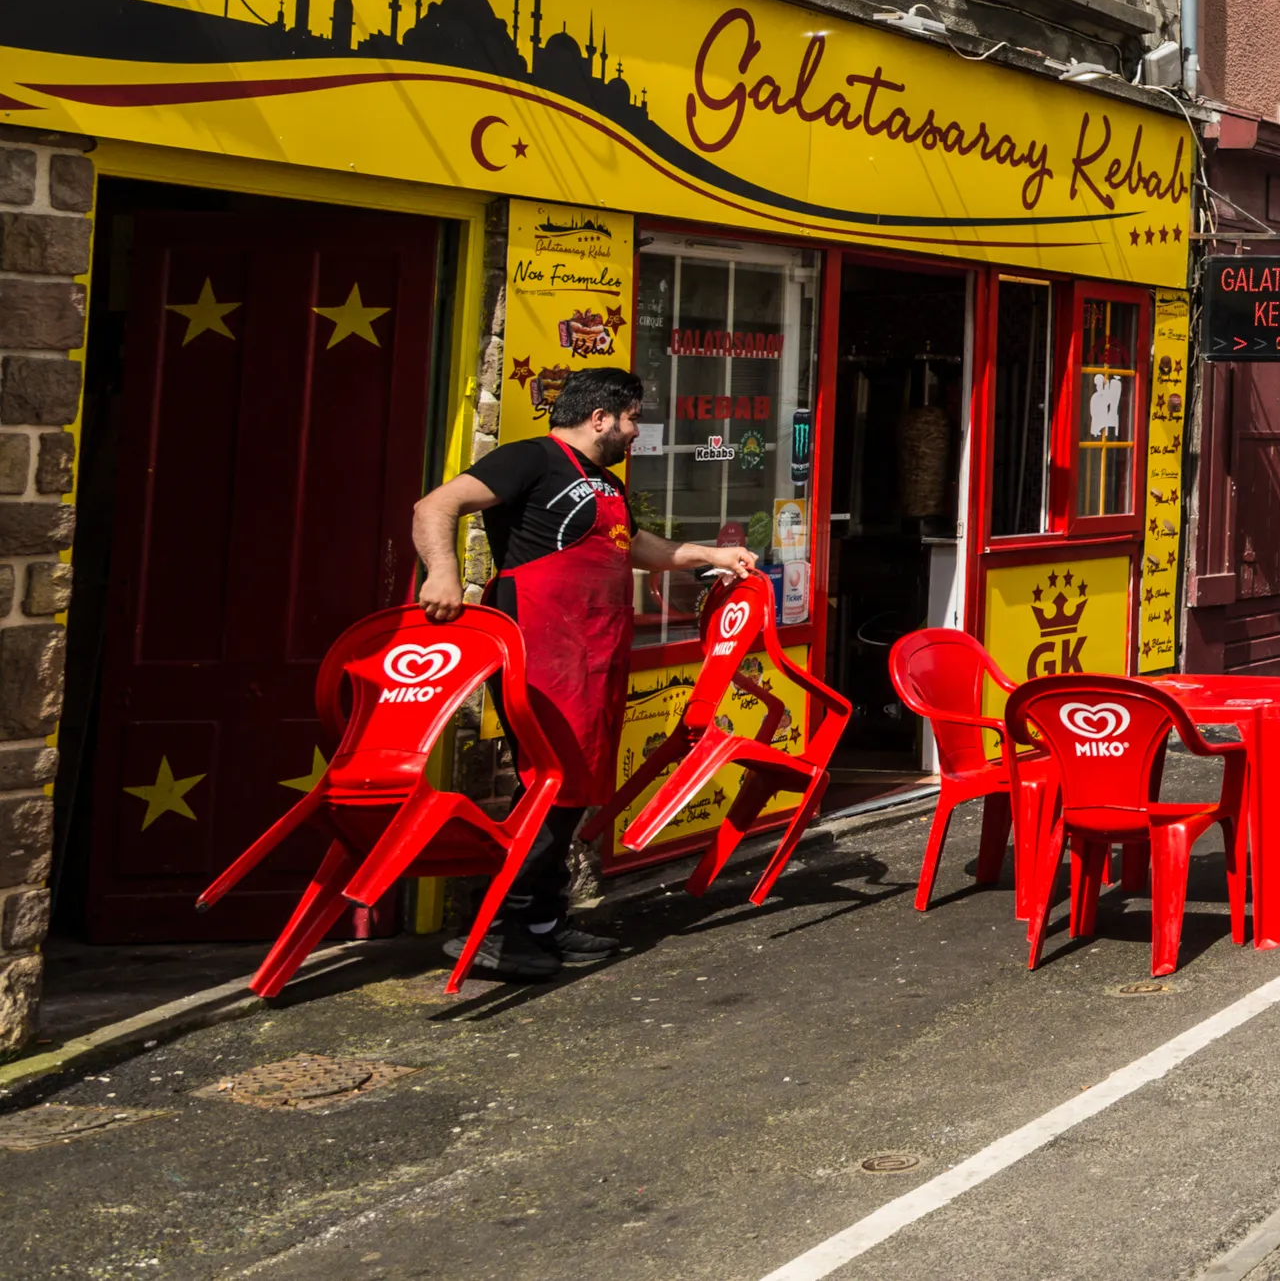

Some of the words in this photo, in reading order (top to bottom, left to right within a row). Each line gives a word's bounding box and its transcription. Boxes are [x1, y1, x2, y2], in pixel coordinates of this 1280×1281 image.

[686, 8, 1054, 210] Galatasaray
[1069, 112, 1189, 210] Kebab
[534, 239, 586, 260] Galatasaray
[588, 245, 611, 259] Kebab
[513, 260, 545, 284] Nos
[550, 263, 622, 289] Formules
[608, 315, 621, 327] 5€
[572, 338, 616, 359] Kebab
[670, 328, 785, 359] GALATASARAY
[676, 396, 772, 421] KEBAB
[696, 448, 734, 459] Kebabs
[712, 641, 734, 656] MIKO
[1027, 636, 1088, 680] GK
[378, 686, 436, 703] MIKO
[1075, 741, 1125, 757] MIKO
